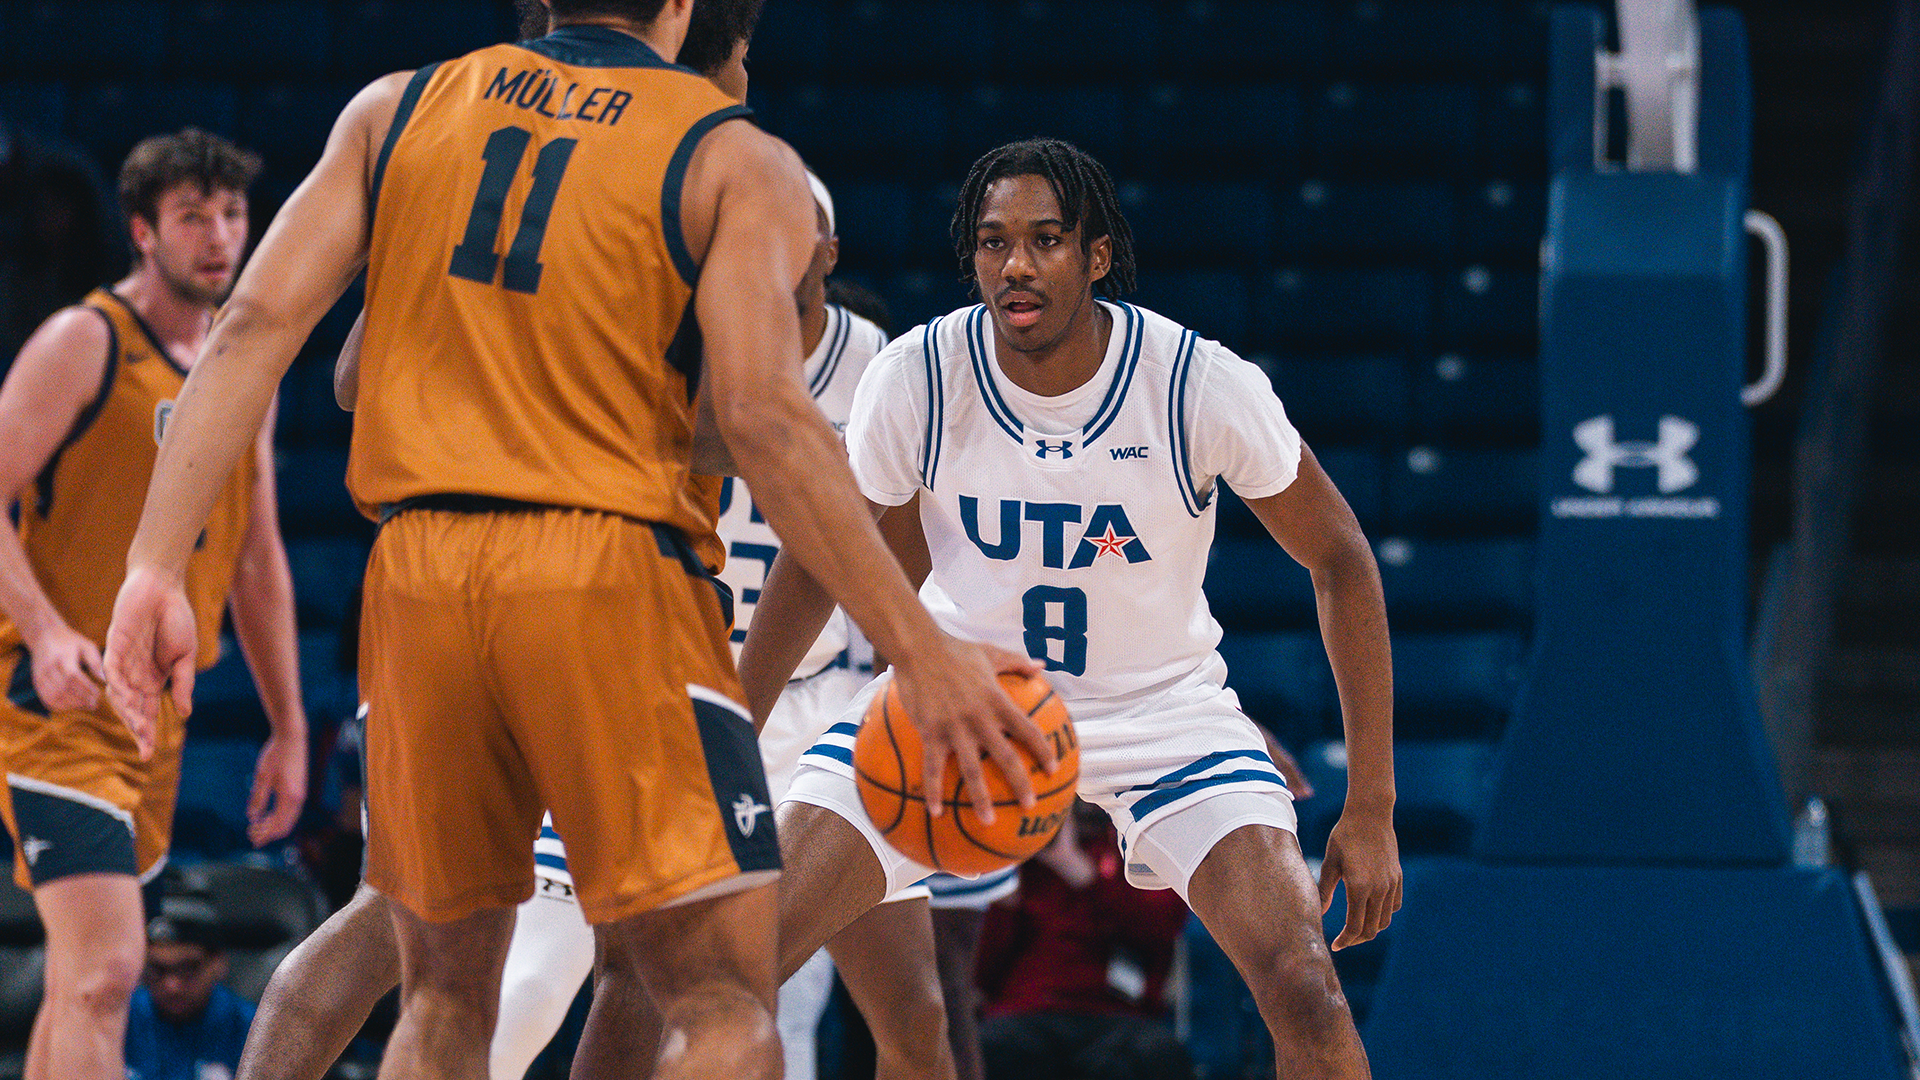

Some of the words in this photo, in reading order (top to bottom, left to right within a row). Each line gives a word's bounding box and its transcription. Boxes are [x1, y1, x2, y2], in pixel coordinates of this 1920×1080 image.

[483, 67, 634, 126] MÜLLER
[448, 125, 579, 295] 11
[1109, 446, 1150, 461] WAC
[958, 494, 1153, 570] UTA
[1021, 584, 1088, 677] 8
